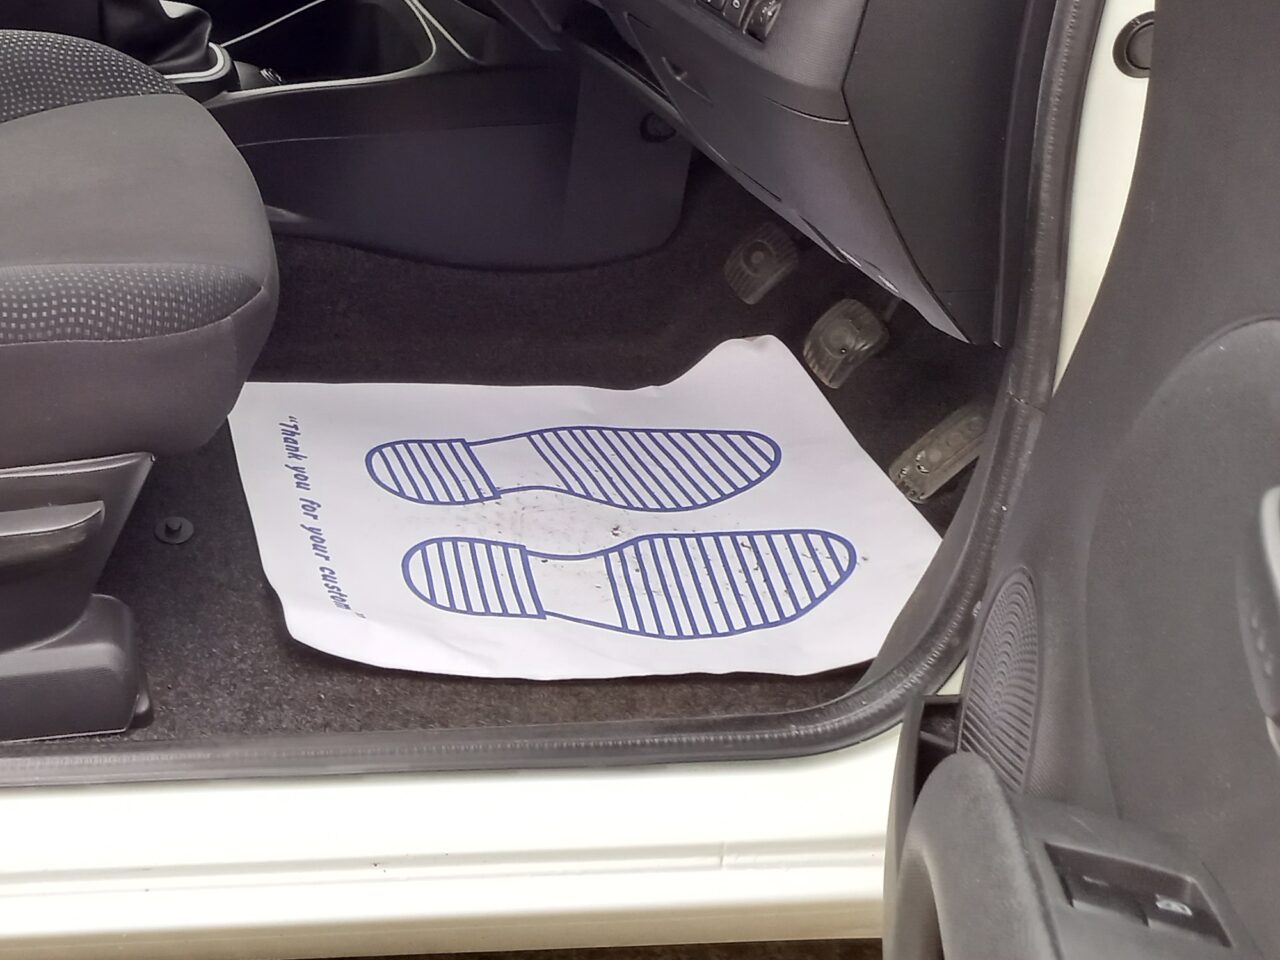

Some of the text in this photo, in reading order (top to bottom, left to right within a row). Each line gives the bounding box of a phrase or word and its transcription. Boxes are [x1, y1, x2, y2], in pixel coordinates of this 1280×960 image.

[284, 463, 312, 491] you
[299, 497, 322, 520] for
[300, 523, 331, 561] your
